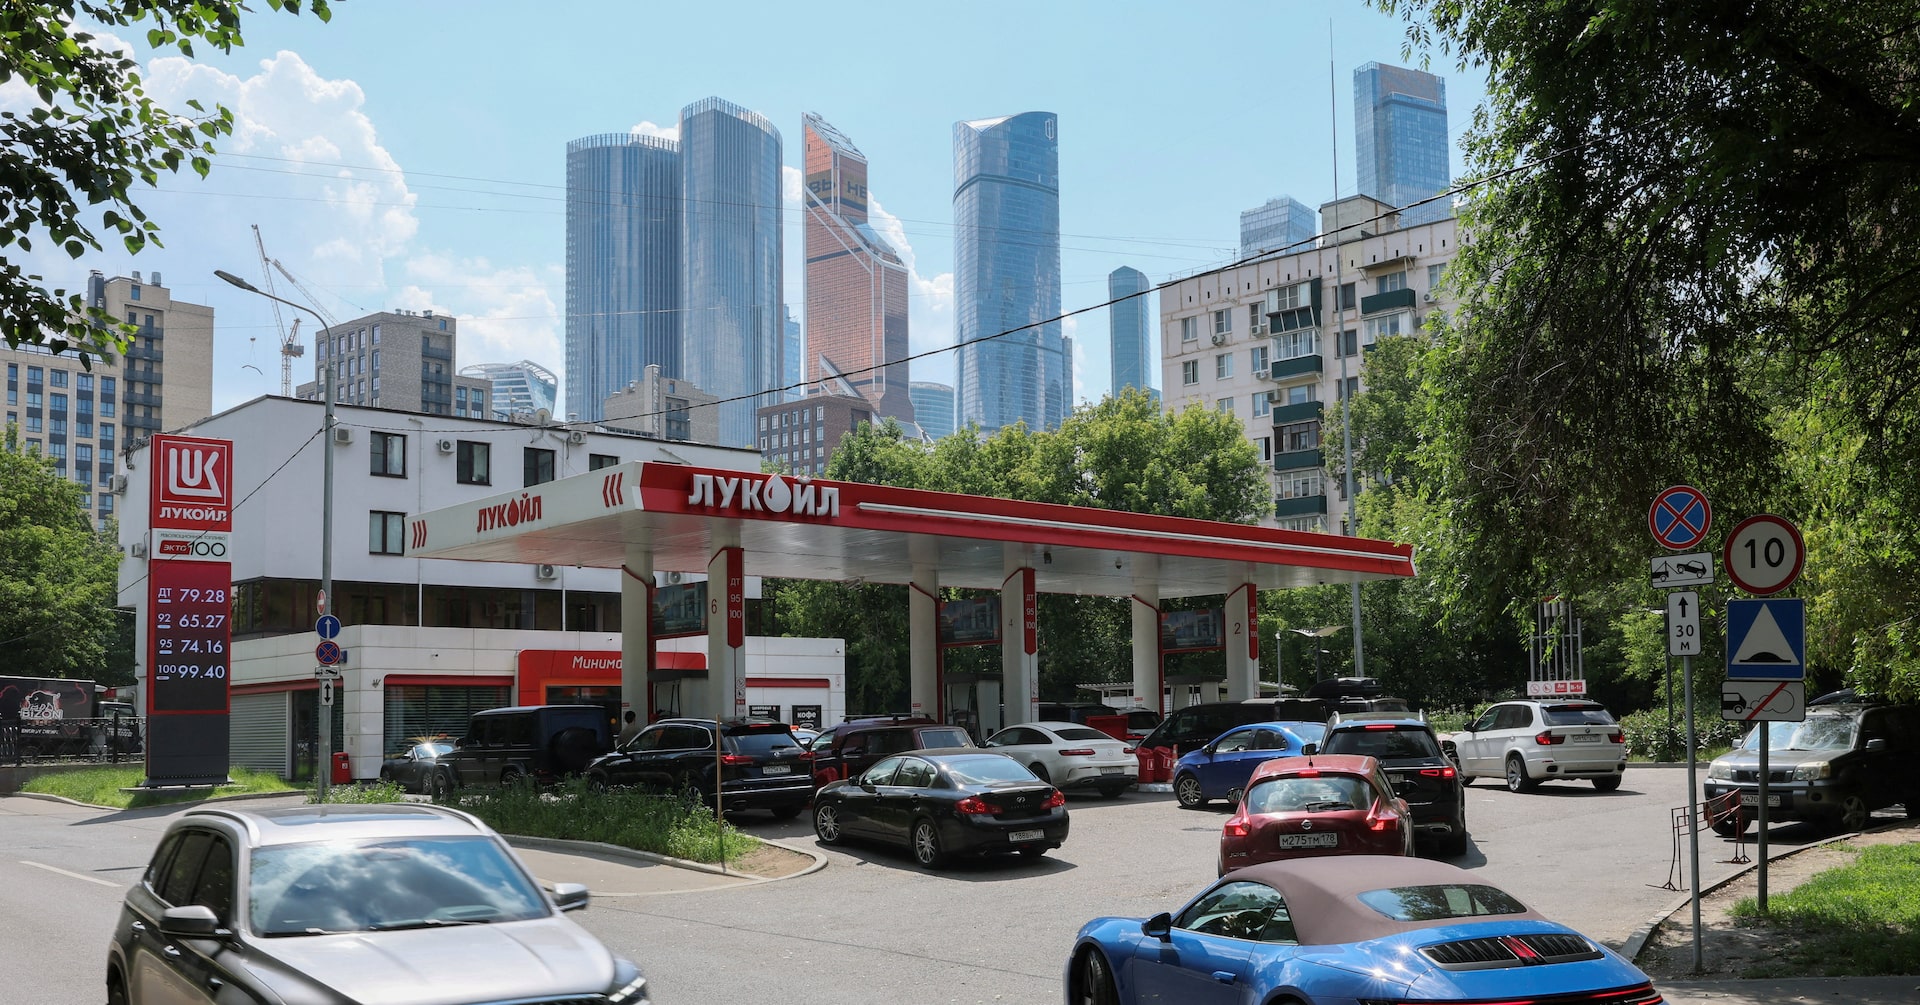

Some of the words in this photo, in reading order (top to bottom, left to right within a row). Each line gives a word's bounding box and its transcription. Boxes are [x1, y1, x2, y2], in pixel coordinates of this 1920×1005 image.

[159, 506, 227, 522] ЛУКОЙЛ
[187, 541, 226, 557] 100
[1744, 537, 1785, 569] 10
[730, 577, 742, 587] ДТ
[158, 587, 173, 599] ДТ
[179, 588, 225, 603] 79.28
[730, 593, 741, 603] 95
[711, 598, 718, 615] 6
[1026, 607, 1035, 616] 95
[157, 613, 171, 623] 92
[179, 614, 225, 628] 65.27
[729, 609, 742, 619] 100
[1234, 622, 1242, 635] 2
[1676, 624, 1695, 638] 30
[159, 639, 173, 649] 95
[180, 639, 223, 654] 74.16
[1680, 641, 1690, 651] М
[158, 664, 177, 674] 100
[178, 664, 225, 679] 99.40
[1321, 834, 1336, 842] 178
